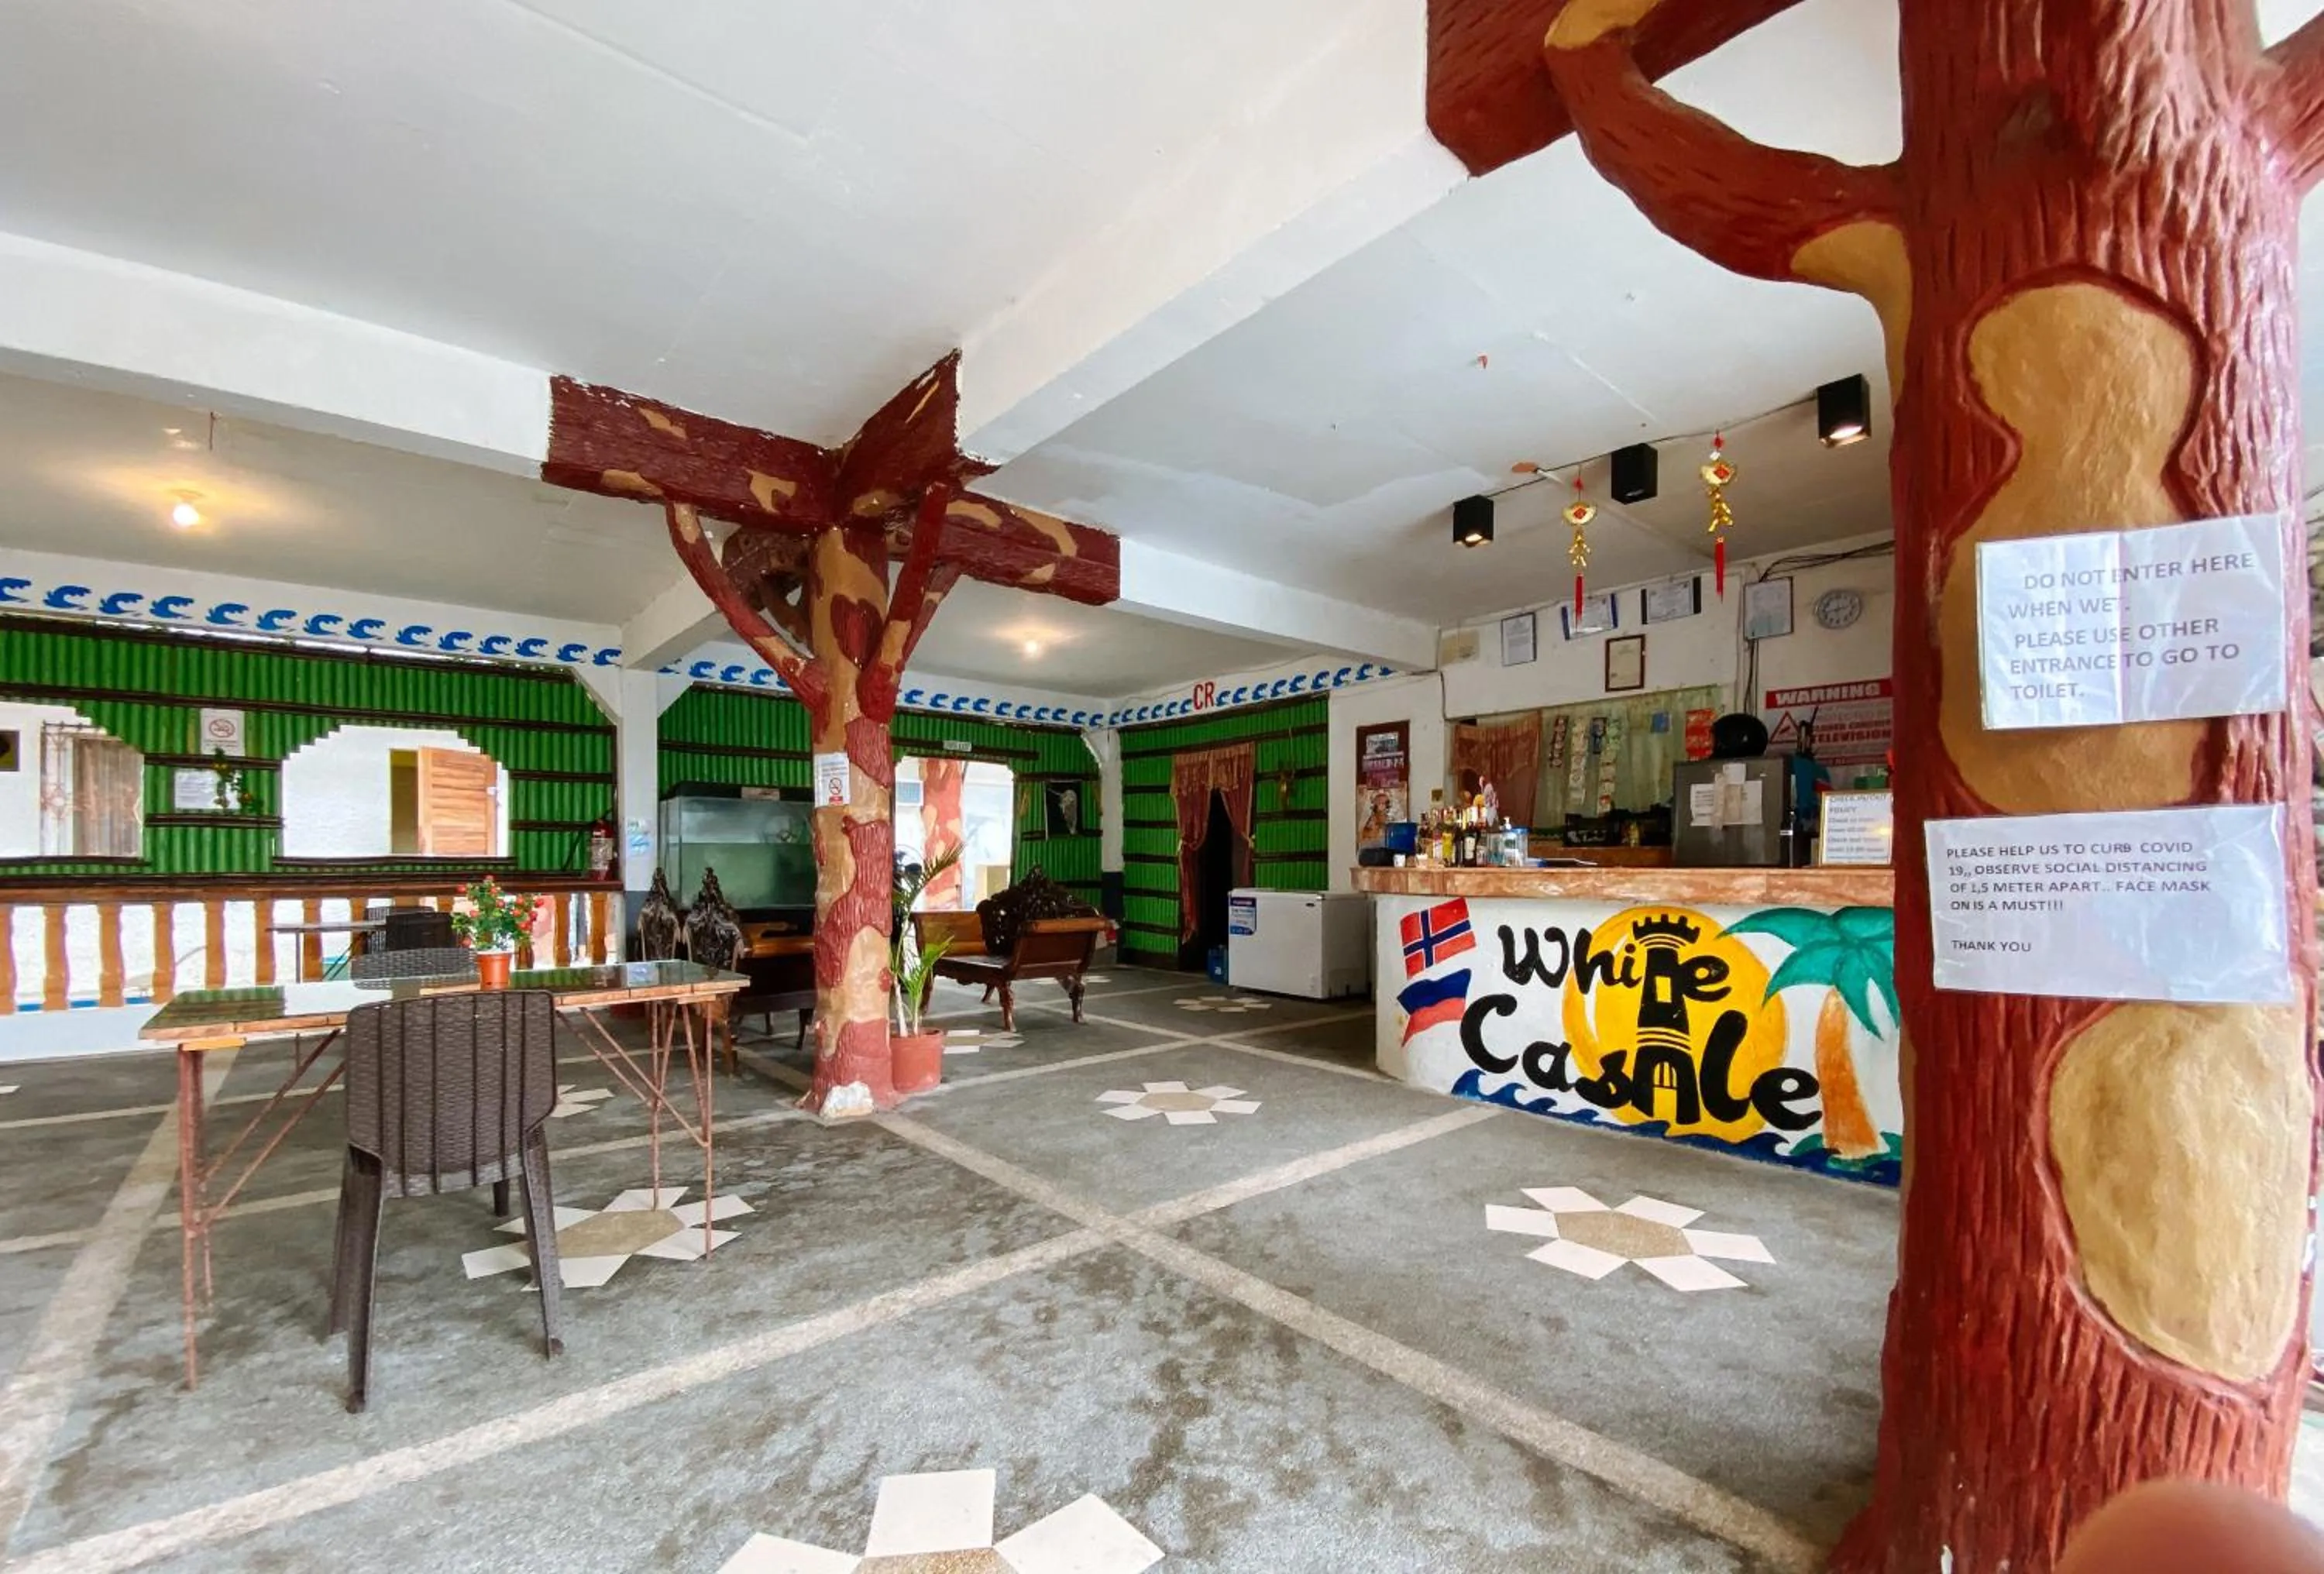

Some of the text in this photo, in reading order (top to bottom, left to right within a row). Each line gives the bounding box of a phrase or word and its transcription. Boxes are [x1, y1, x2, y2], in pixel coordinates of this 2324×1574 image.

[2024, 552, 2256, 589] DO NOT ENTER HERE
[2008, 599, 2072, 619] WHEN
[2016, 618, 2220, 649] PLEASE USE OTHER
[2010, 644, 2240, 675] ENTRANCE TO GO TO
[1194, 682, 1215, 710] CR
[1776, 682, 1881, 704] WARNING
[2010, 682, 2085, 699] TOILET.
[1947, 841, 2193, 859] PLEASE HELP US TO CURB COVID
[1975, 864, 2040, 875] OBSERVE
[2044, 862, 2101, 874] SOCIAL
[2106, 861, 2208, 873] DISTANCING
[1950, 882, 1968, 893] OF
[1993, 882, 2044, 893] METER
[2116, 881, 2155, 892] FACE
[2161, 880, 2211, 892] MASK
[1951, 900, 2064, 912] ON IS A MUST!!!
[1951, 940, 2032, 953] THANK YOU
